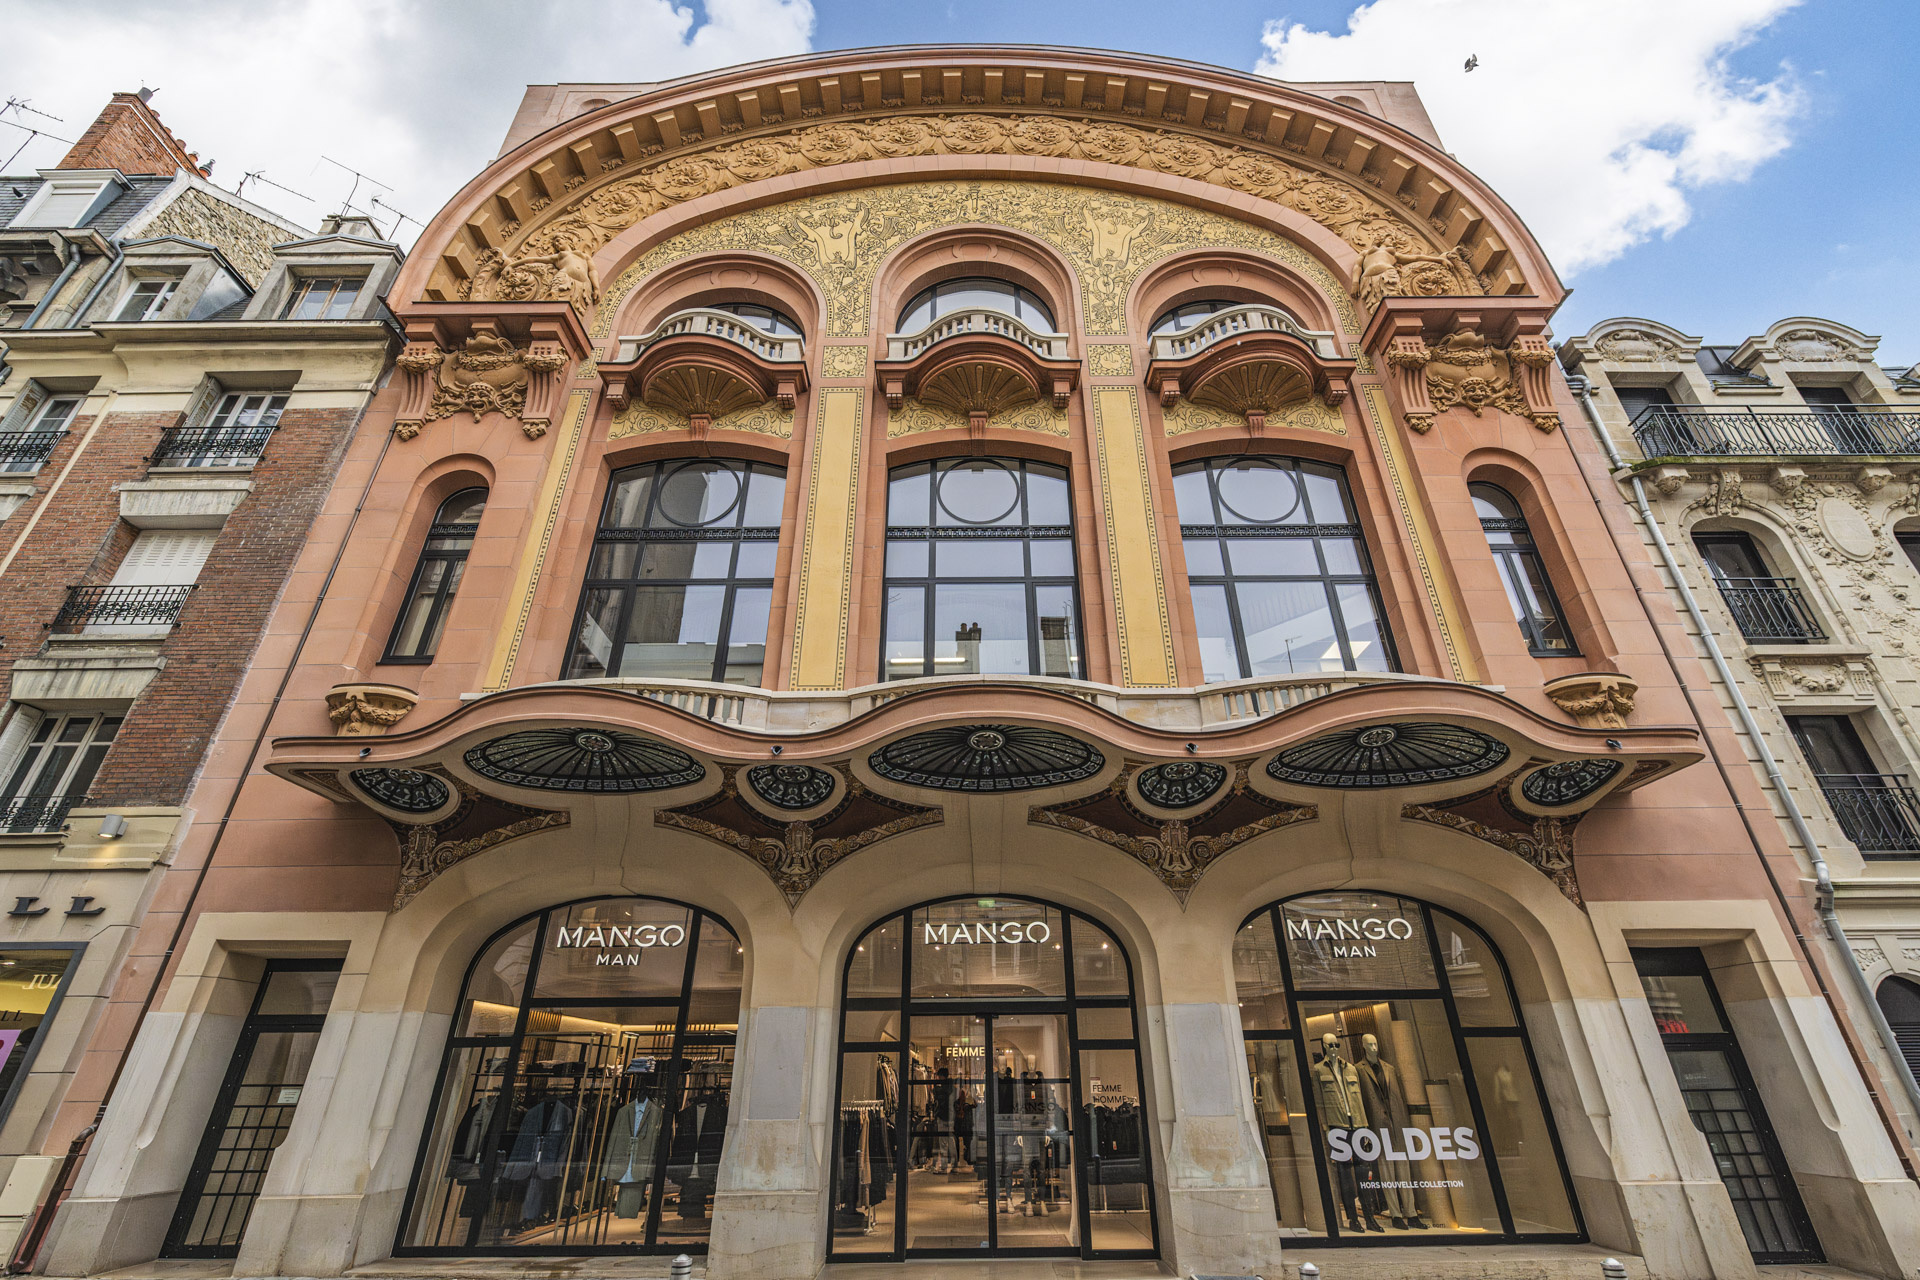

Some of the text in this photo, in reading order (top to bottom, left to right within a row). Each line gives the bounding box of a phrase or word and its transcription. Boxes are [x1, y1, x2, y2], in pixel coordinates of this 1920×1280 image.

[925, 921, 1050, 945] MANGO
[1286, 918, 1412, 940] MANGO
[557, 924, 685, 948] MANGO
[1333, 945, 1377, 958] MAN
[596, 953, 639, 966] MAN
[946, 1047, 985, 1057] FEMME
[1092, 1084, 1122, 1093] FEMME
[1093, 1095, 1127, 1104] HOMME
[1327, 1127, 1480, 1162] SOLDES
[1360, 1180, 1464, 1189] HORS NOUVELLE COLLECTION
